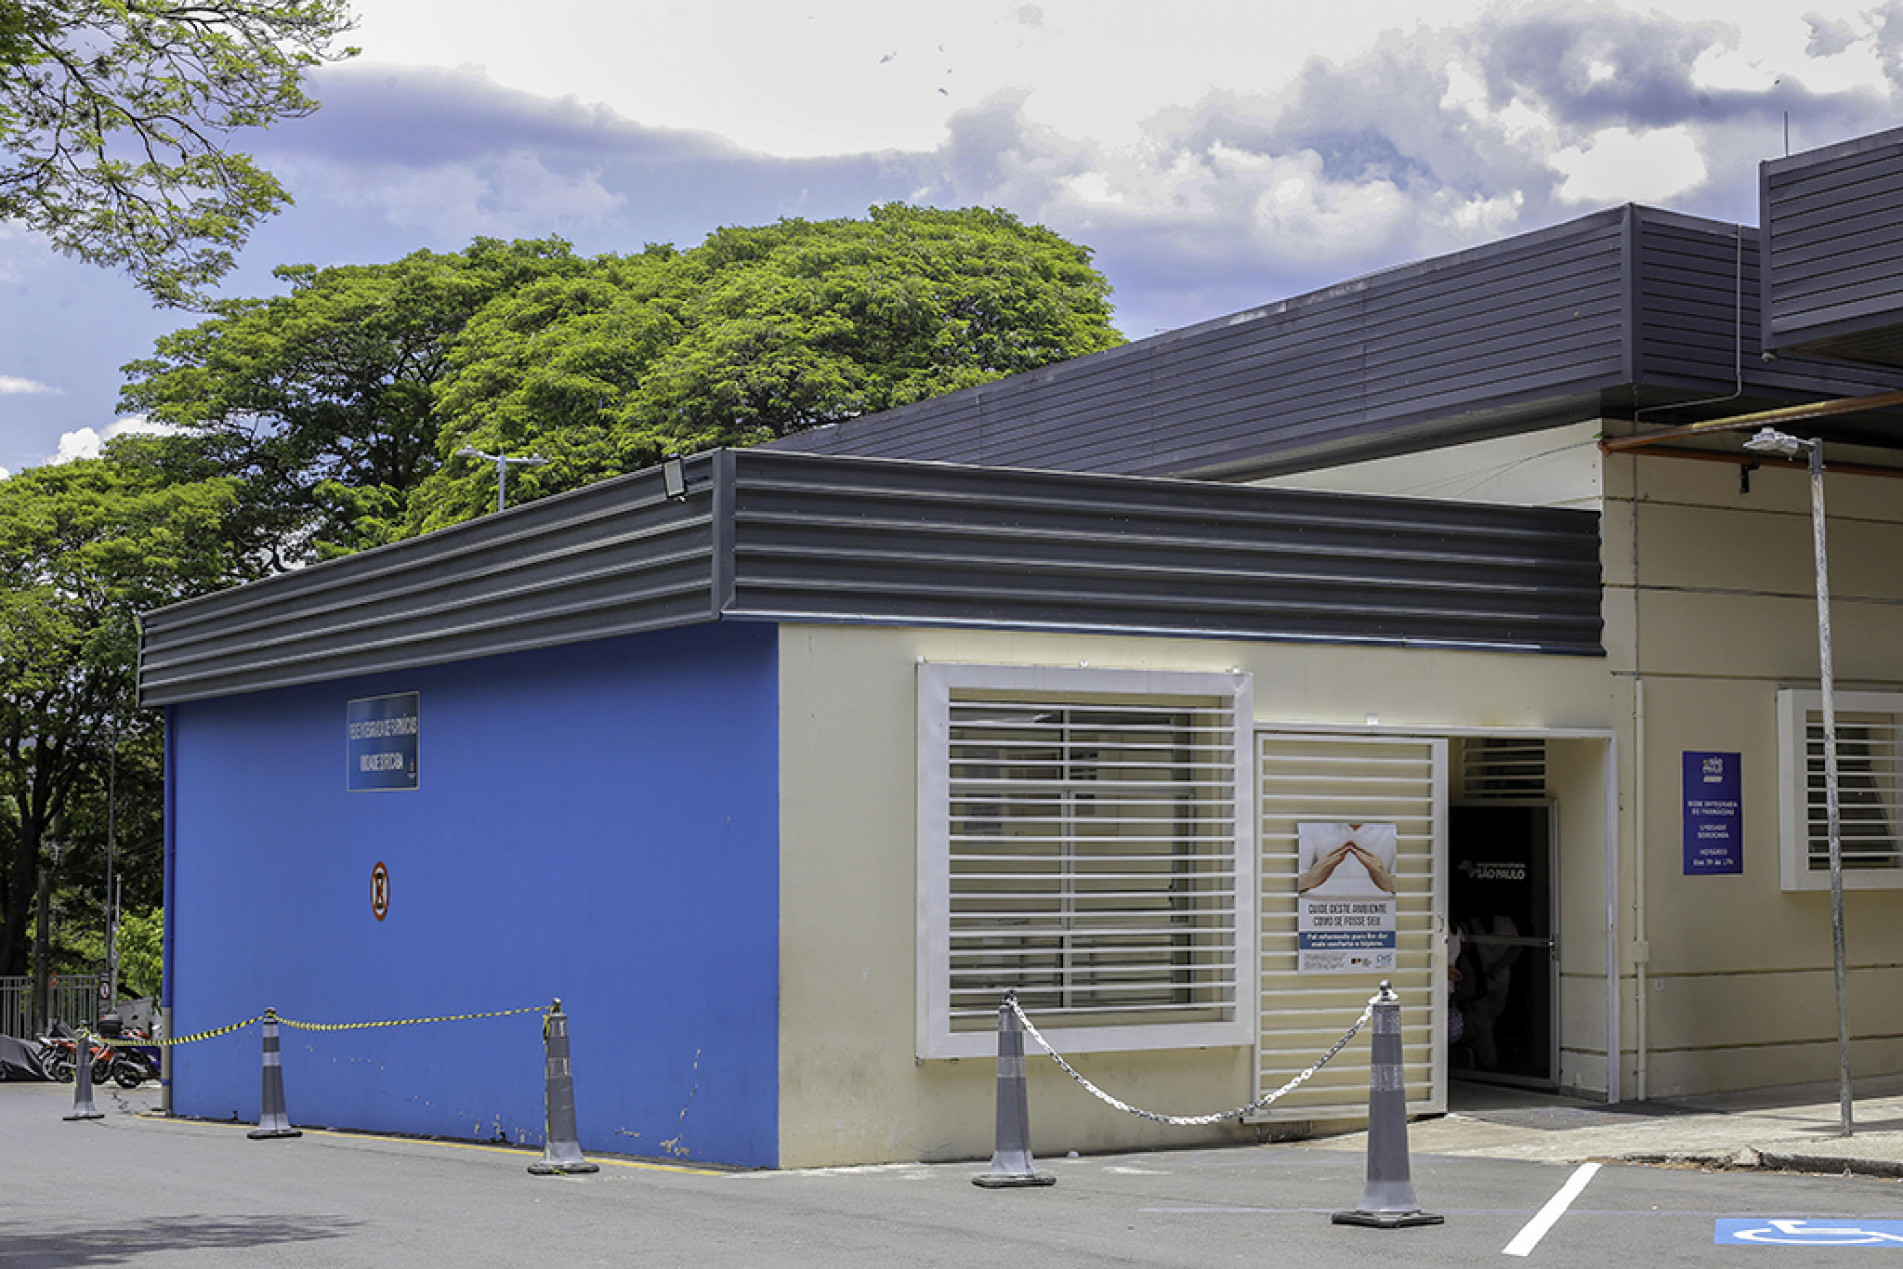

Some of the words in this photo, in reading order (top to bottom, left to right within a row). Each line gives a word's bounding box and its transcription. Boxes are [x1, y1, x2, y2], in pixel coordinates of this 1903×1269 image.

[1495, 868, 1526, 880] PAULO
[1308, 904, 1328, 915] CUIDE
[1329, 904, 1350, 915] DESTE
[1334, 916, 1342, 927] SE
[1344, 916, 1365, 927] FOSSE
